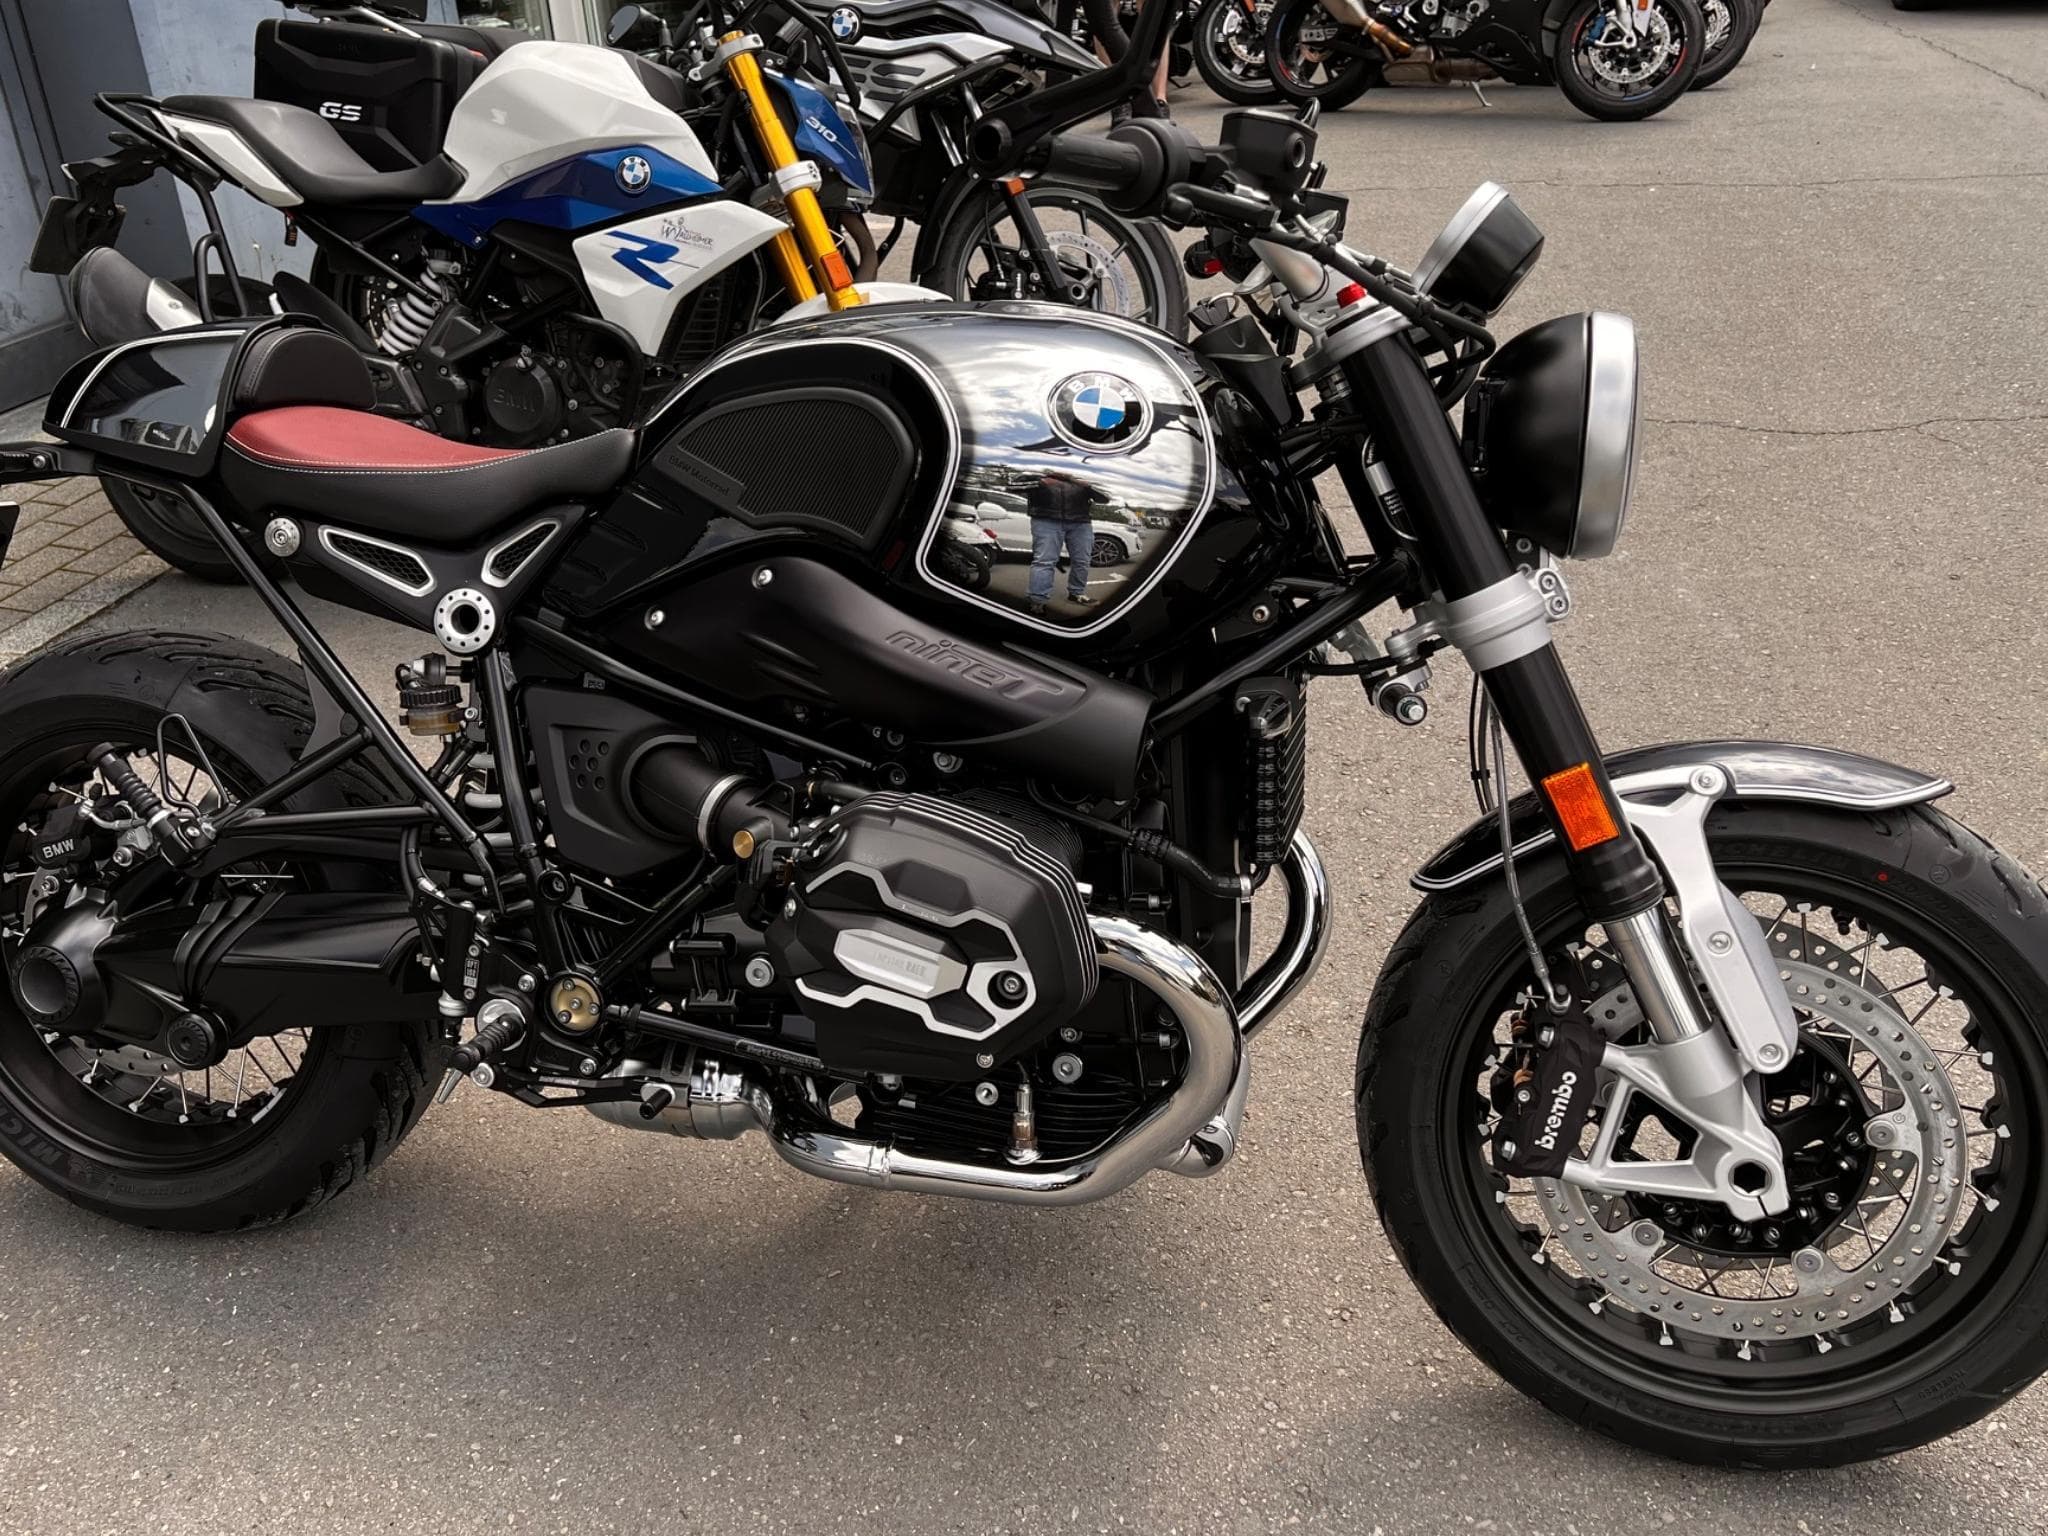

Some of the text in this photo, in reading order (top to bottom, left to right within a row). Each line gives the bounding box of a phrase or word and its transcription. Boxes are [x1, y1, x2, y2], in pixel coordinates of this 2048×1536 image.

[319, 101, 362, 121] GS
[805, 116, 838, 142] 310
[669, 455, 692, 473] BMW
[41, 838, 75, 859] BMW
[1534, 1070, 1577, 1151] brembo
